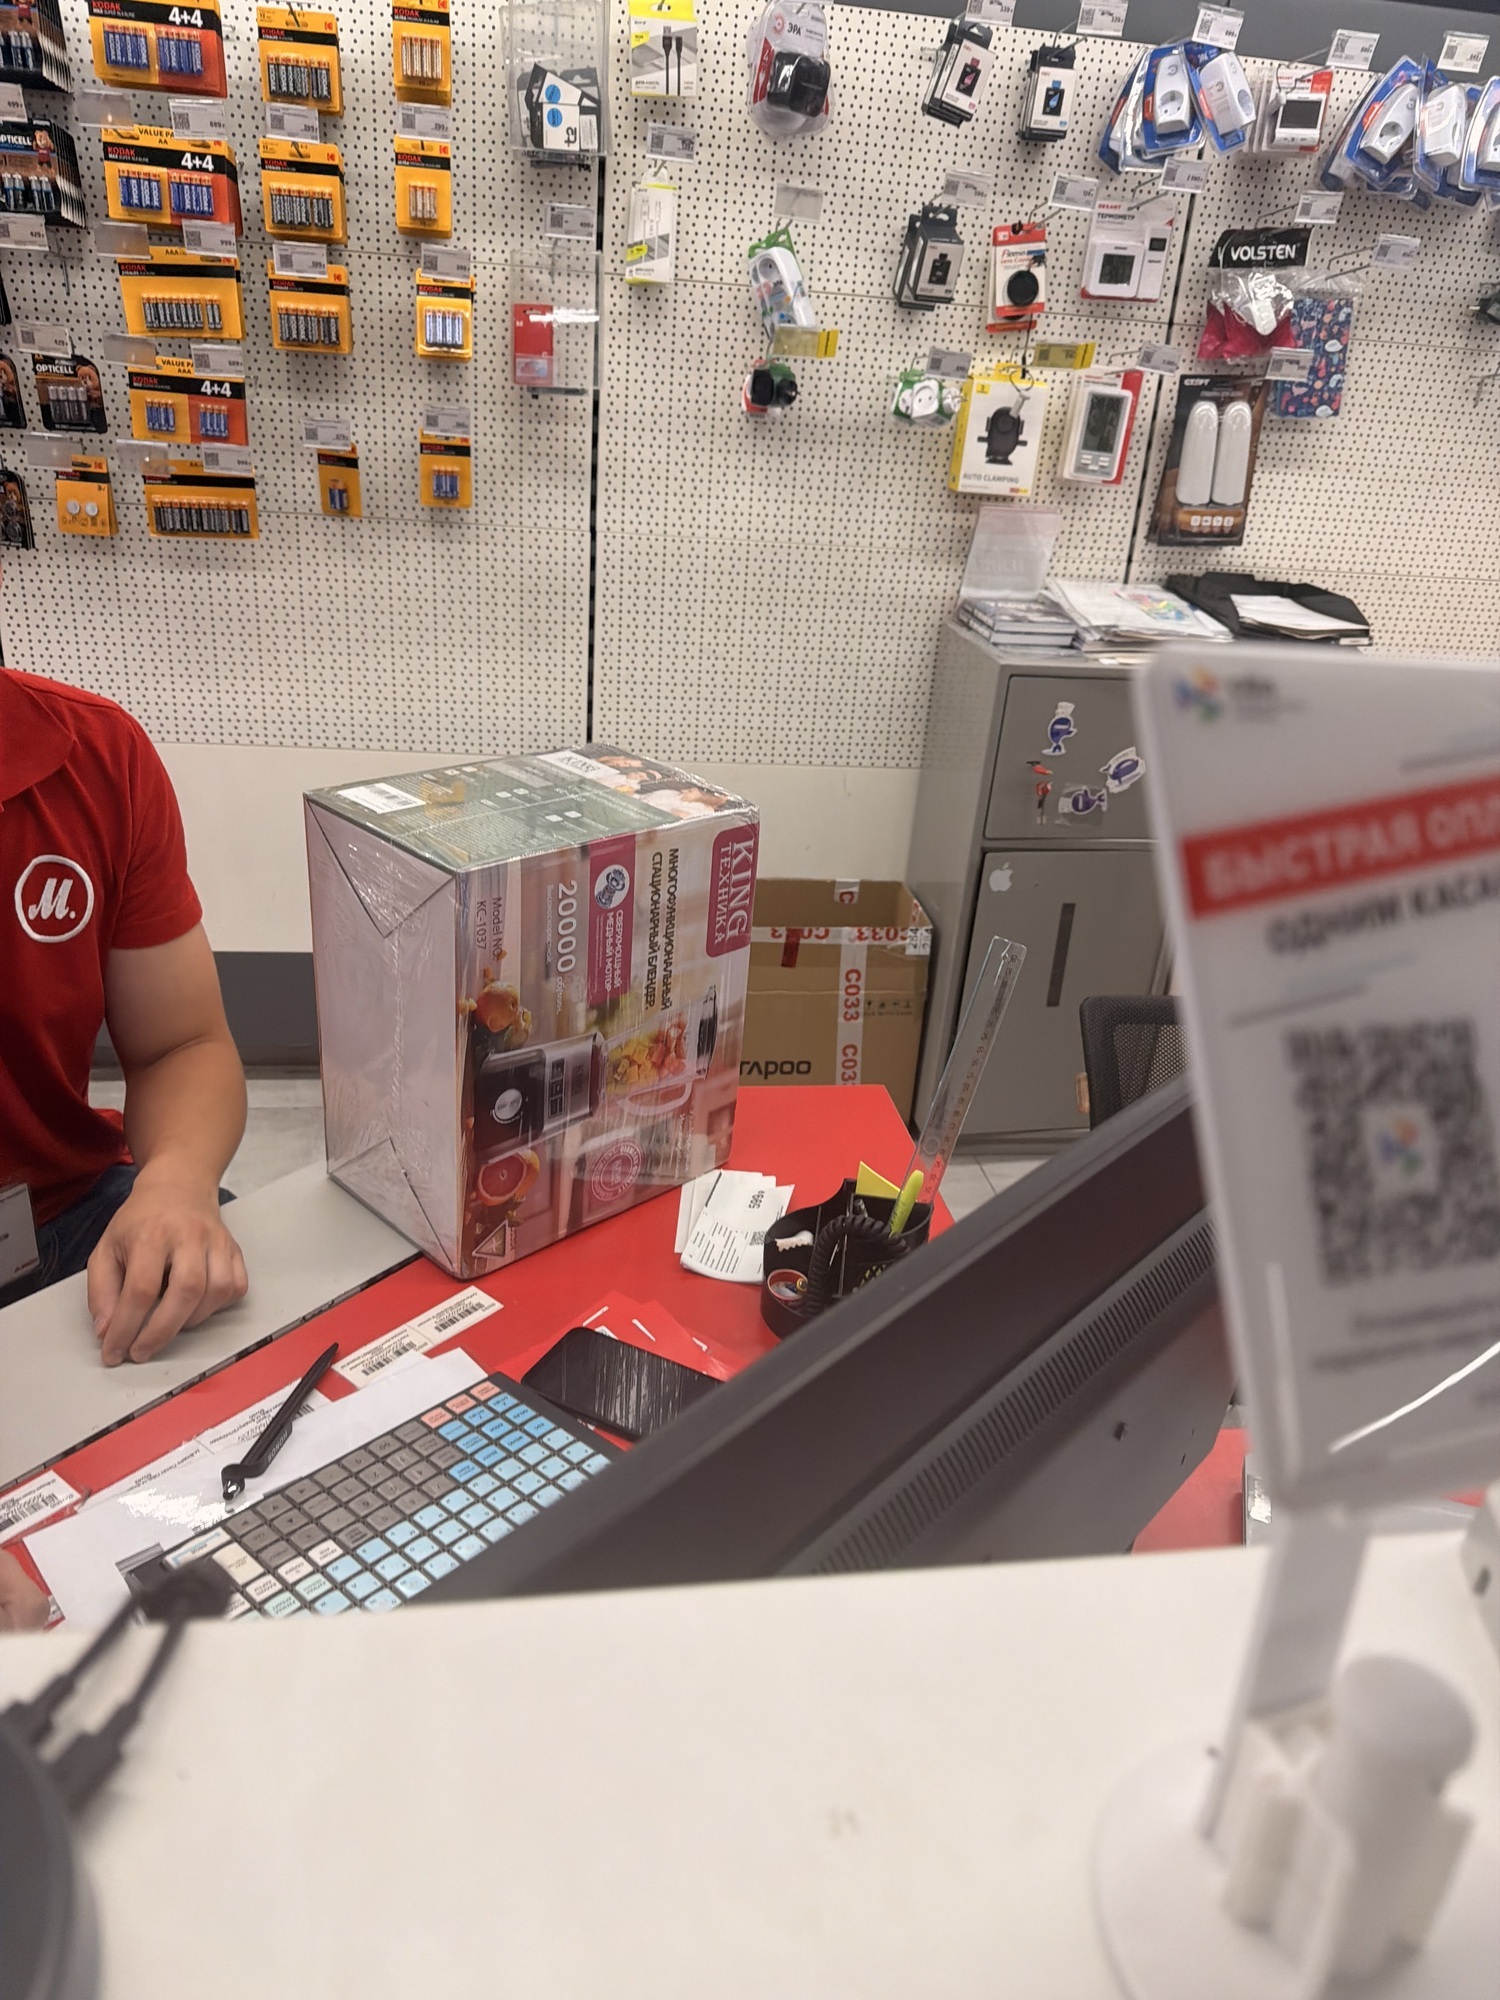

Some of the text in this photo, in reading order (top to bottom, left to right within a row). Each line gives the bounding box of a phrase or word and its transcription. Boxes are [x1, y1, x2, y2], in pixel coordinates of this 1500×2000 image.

[91, 0, 121, 11] KODAK
[394, 7, 420, 17] KODAK
[168, 6, 203, 28] 4+4
[787, 22, 802, 36] ЭРА
[138, 127, 163, 138] VALUE
[107, 146, 135, 156] KODAK
[397, 154, 422, 163] KODAK
[181, 152, 214, 172] 4+4
[1097, 213, 1136, 221] ТЕРМОМЕТР
[1230, 244, 1297, 261] VOLSTEN
[121, 264, 146, 272] KODAK
[418, 285, 442, 293] KODAK
[35, 364, 74, 375] OPTICELL
[161, 359, 185, 368] VALUE
[132, 376, 158, 385] KODAK
[201, 380, 232, 398] 4+4
[962, 472, 1020, 484] AUTO CLAMPING
[714, 842, 733, 945] ТЕХНИКА
[725, 837, 755, 941] KING
[648, 852, 663, 954] СТАЦИОНАРНЫЙ
[477, 900, 487, 950] KC-1037
[492, 897, 502, 935] Model
[557, 880, 578, 973] 20000
[661, 848, 679, 1011] МНОГОФУНКЦИОНАЛЬНЫЙ
[603, 912, 614, 993] МЕДНЫЙ МОТОР
[614, 910, 624, 988] СВЕРХМОЩНЫЙ
[843, 968, 862, 1022] C033
[841, 1044, 858, 1085] C03
[267, 1431, 288, 1463] HONOR
